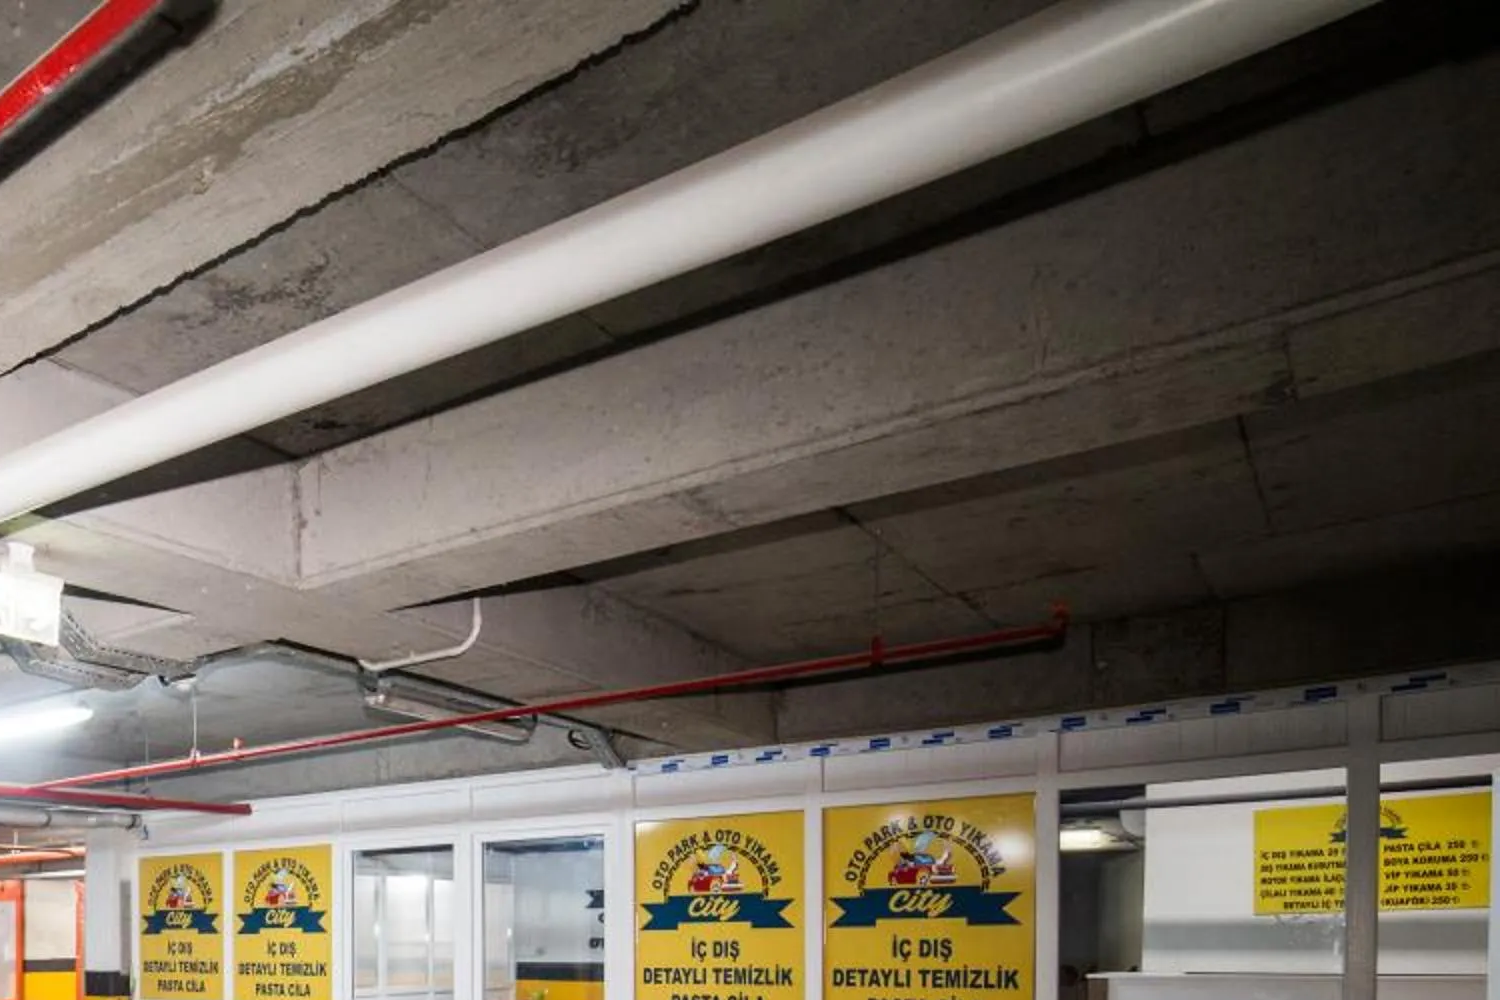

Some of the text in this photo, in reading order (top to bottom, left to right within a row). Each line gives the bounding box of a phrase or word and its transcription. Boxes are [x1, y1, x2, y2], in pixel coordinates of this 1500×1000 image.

[652, 861, 669, 890] OTO
[668, 834, 699, 860] PARK
[715, 830, 741, 842] OTO
[745, 836, 782, 885] YIKAMA
[845, 850, 865, 882] OTO
[864, 820, 902, 847] PARK
[924, 815, 955, 830] OTO
[959, 821, 1006, 877] YIKAMA
[688, 895, 740, 921] City
[888, 888, 952, 917] City
[265, 909, 296, 927] City
[267, 941, 296, 958] İÇ DIŞ
[692, 937, 739, 962] İÇ DIŞ
[892, 934, 953, 962] İÇ DIŞ
[238, 959, 326, 977] DETAYLI TEMİZLİK
[644, 964, 793, 986] DETAYLI TEMİZLİK
[833, 964, 1019, 990] DETAYLI TEMİZLİK
[255, 983, 311, 997] PASTA CİLA
